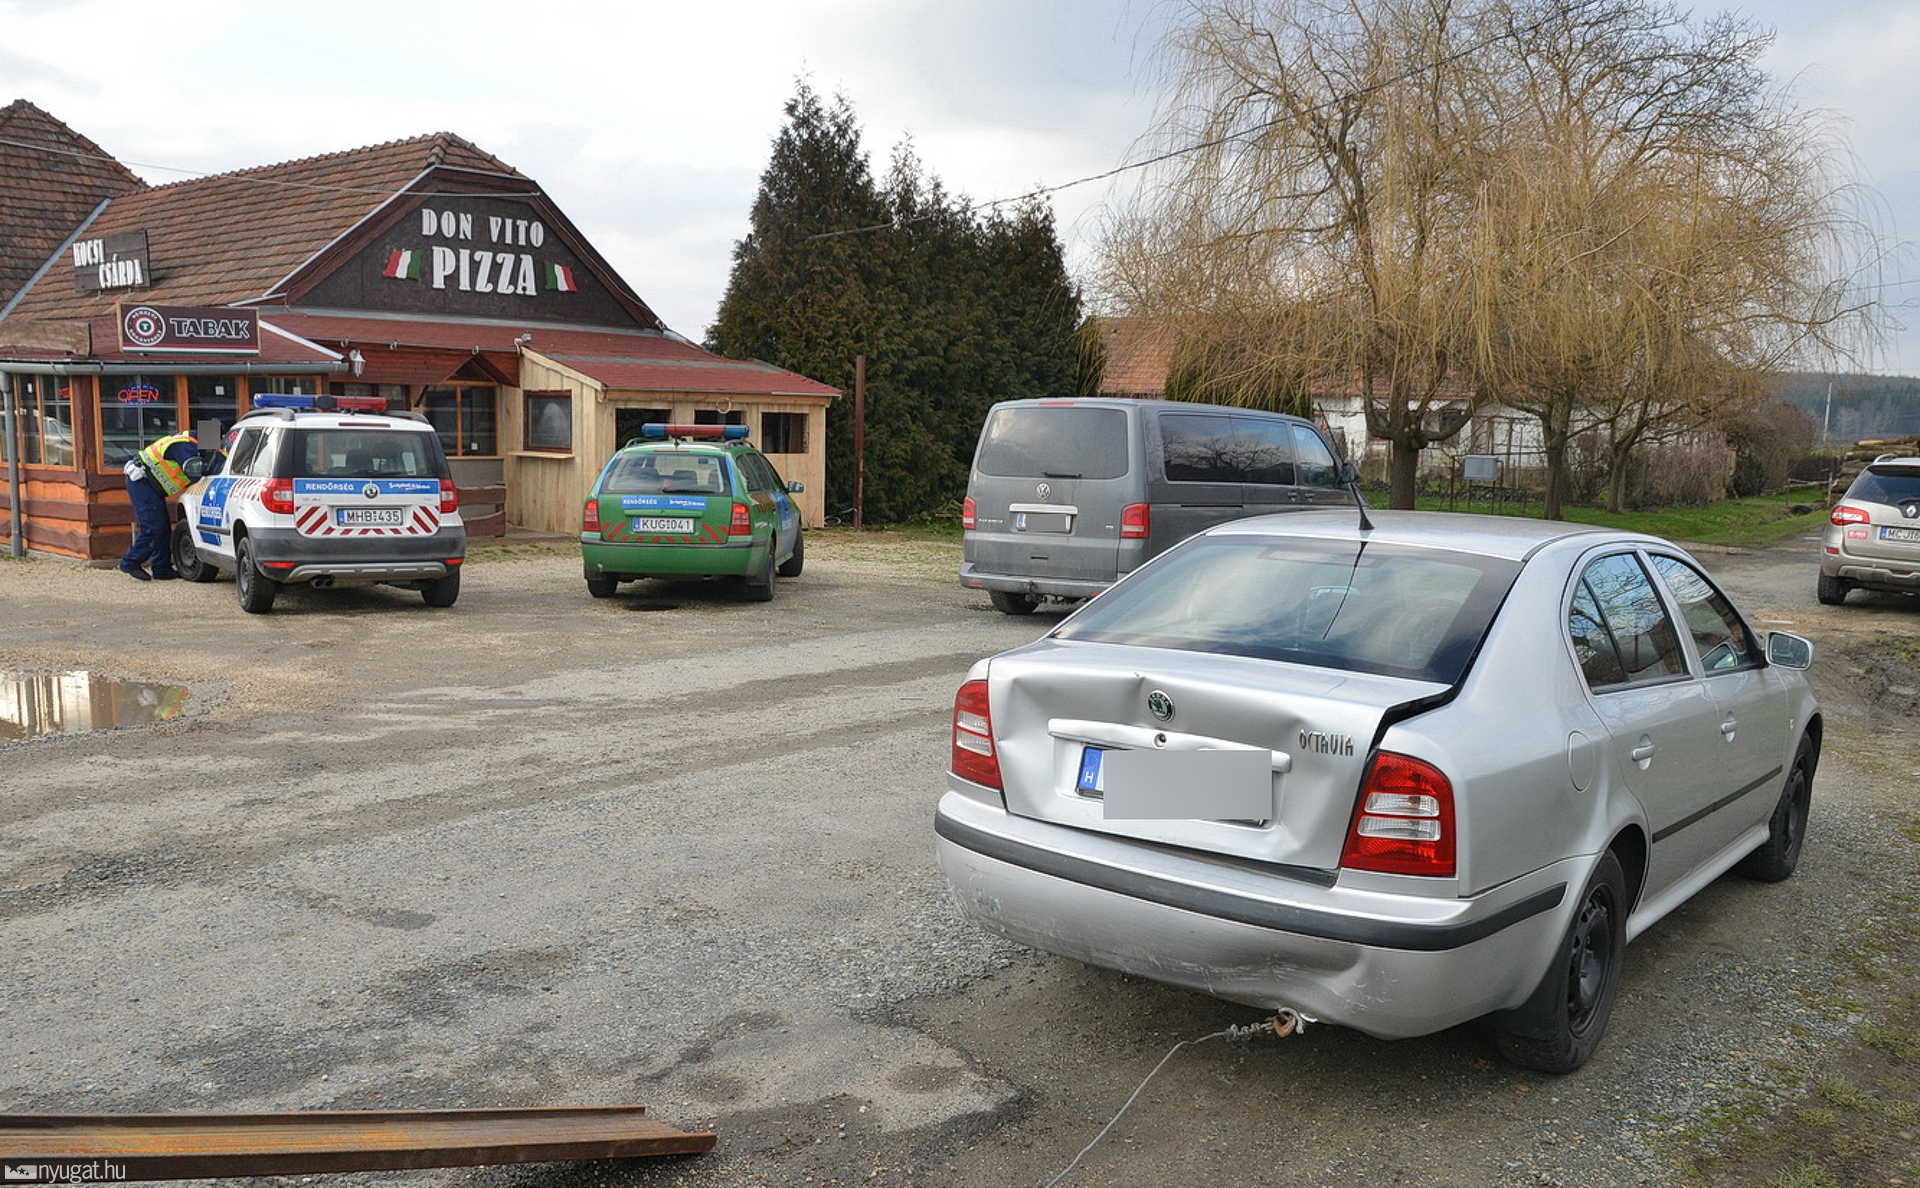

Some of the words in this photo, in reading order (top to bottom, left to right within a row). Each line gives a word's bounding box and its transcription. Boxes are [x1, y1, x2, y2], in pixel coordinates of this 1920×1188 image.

[422, 209, 472, 239] DON
[489, 216, 544, 248] VITO
[73, 240, 104, 267] KOCSI
[99, 254, 142, 288] CSÁRDA
[431, 246, 537, 296] PIZZA
[170, 318, 250, 339] TABAK
[115, 389, 160, 402] OPEN
[1300, 730, 1353, 757] OCTAVIA
[1083, 770, 1094, 783] H
